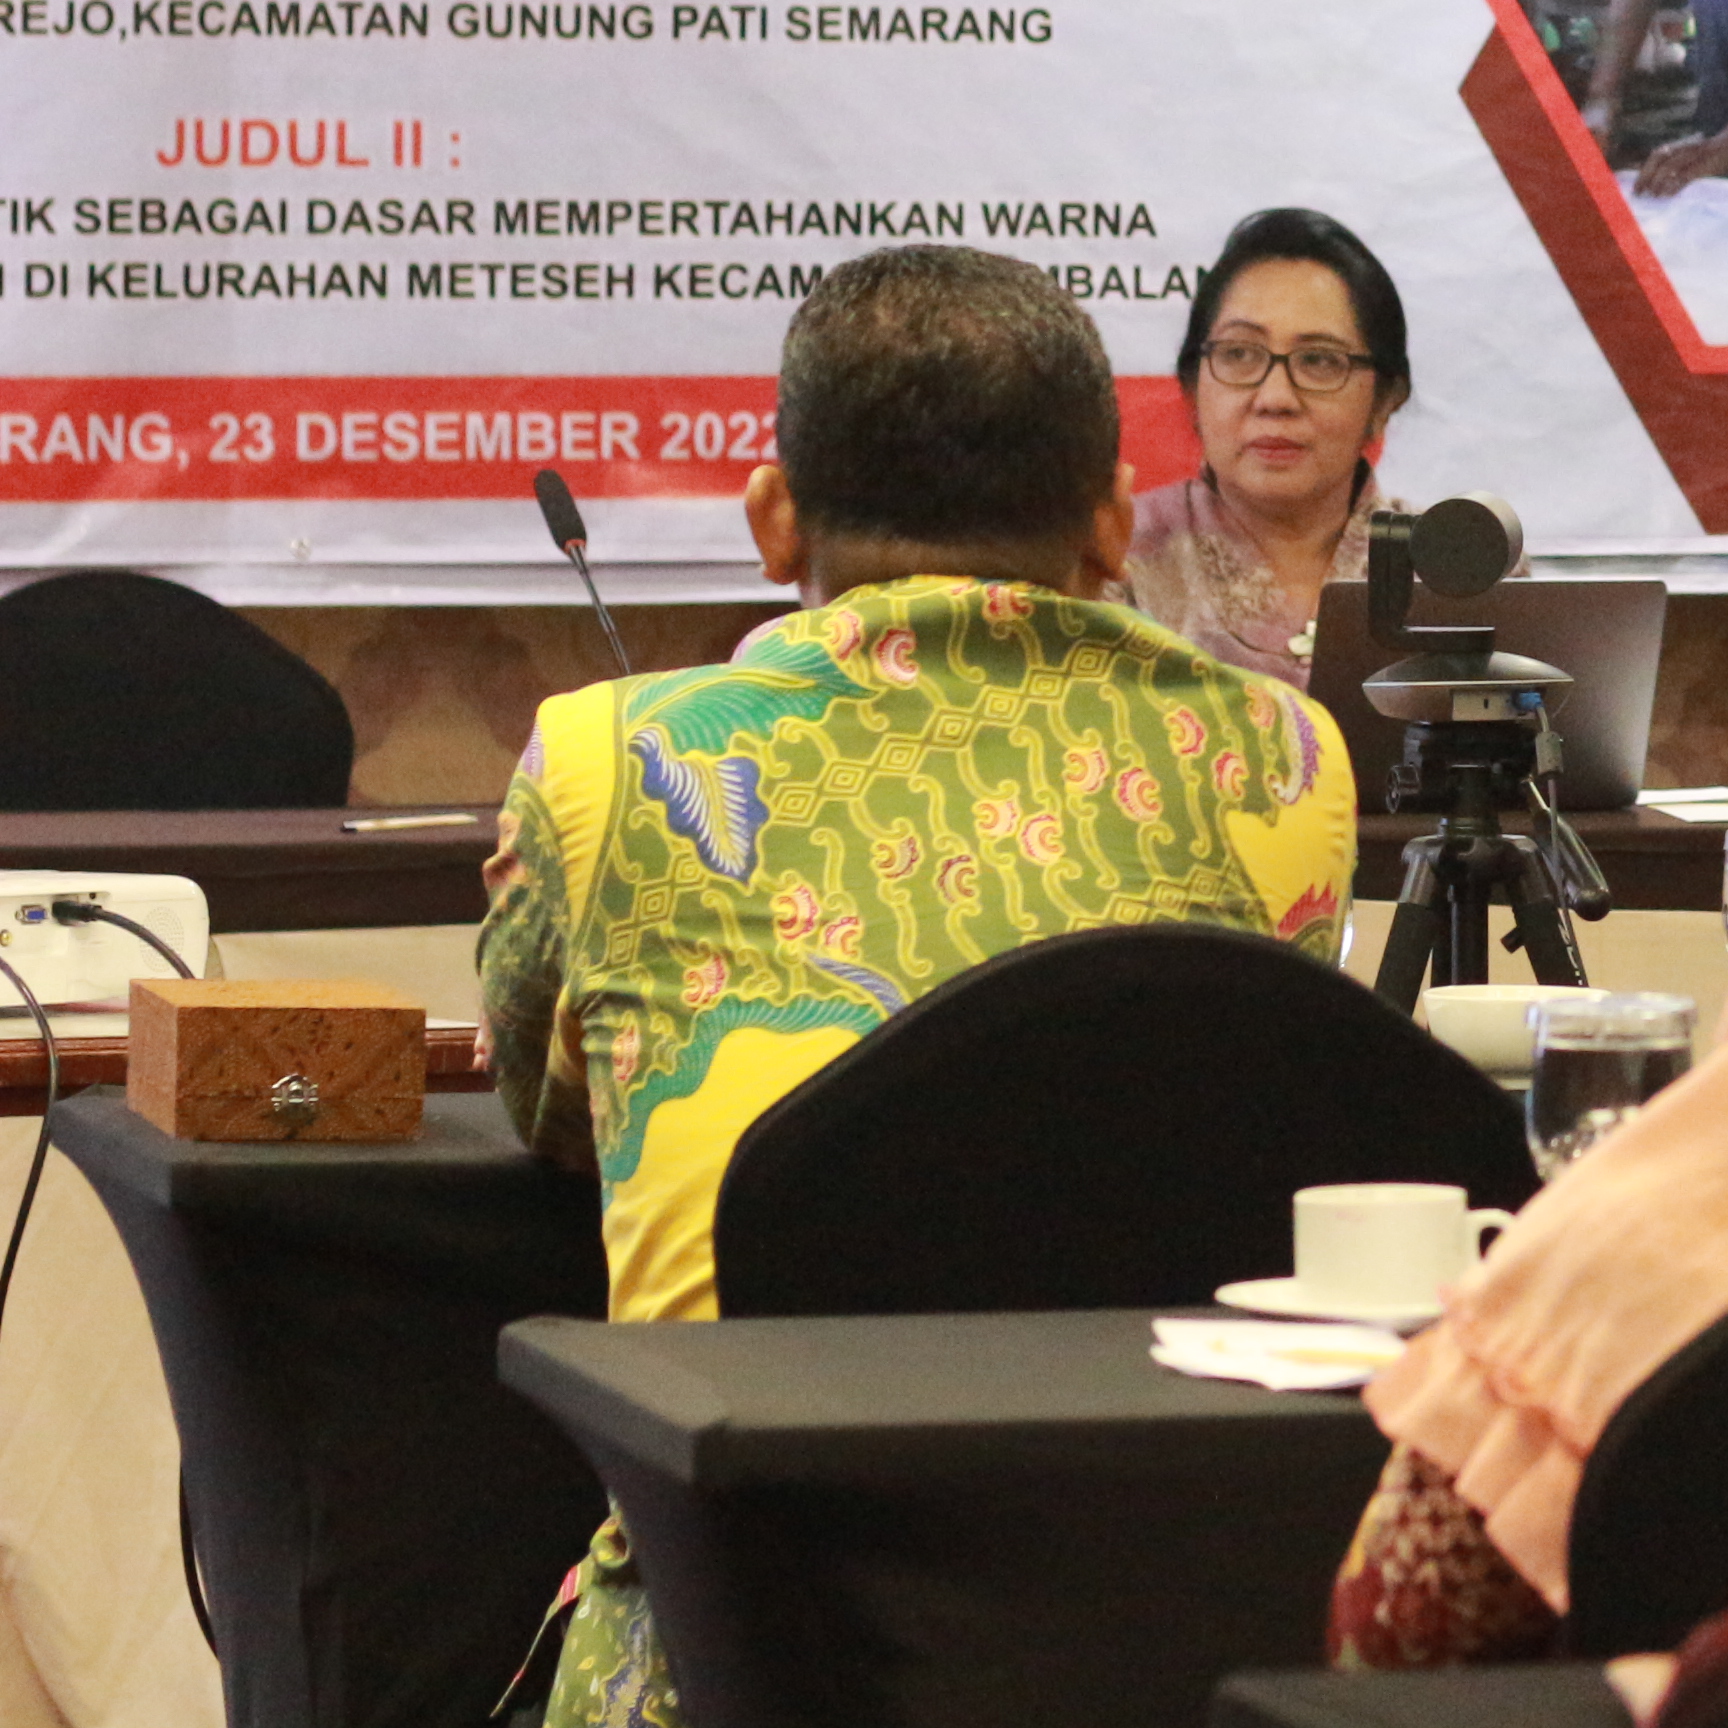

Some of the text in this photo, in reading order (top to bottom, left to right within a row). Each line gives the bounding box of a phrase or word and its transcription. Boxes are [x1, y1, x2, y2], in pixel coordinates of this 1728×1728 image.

[445, 1, 656, 41] GUNUNG
[670, 3, 769, 41] PATI
[784, 5, 1054, 44] SEMARANG
[156, 119, 369, 168] JUDUL
[393, 121, 424, 168] II
[0, 197, 1158, 239] IK SEBAGAI DASAR MEMPERTAHANKAN WARNA
[23, 262, 70, 299] DI
[86, 262, 389, 300] KELURAHAN
[406, 262, 636, 300] METESEH
[1048, 264, 1212, 301] BALA
[0, 411, 190, 469] RANG,
[207, 411, 276, 462] 23
[295, 411, 641, 463] DESEMBER
